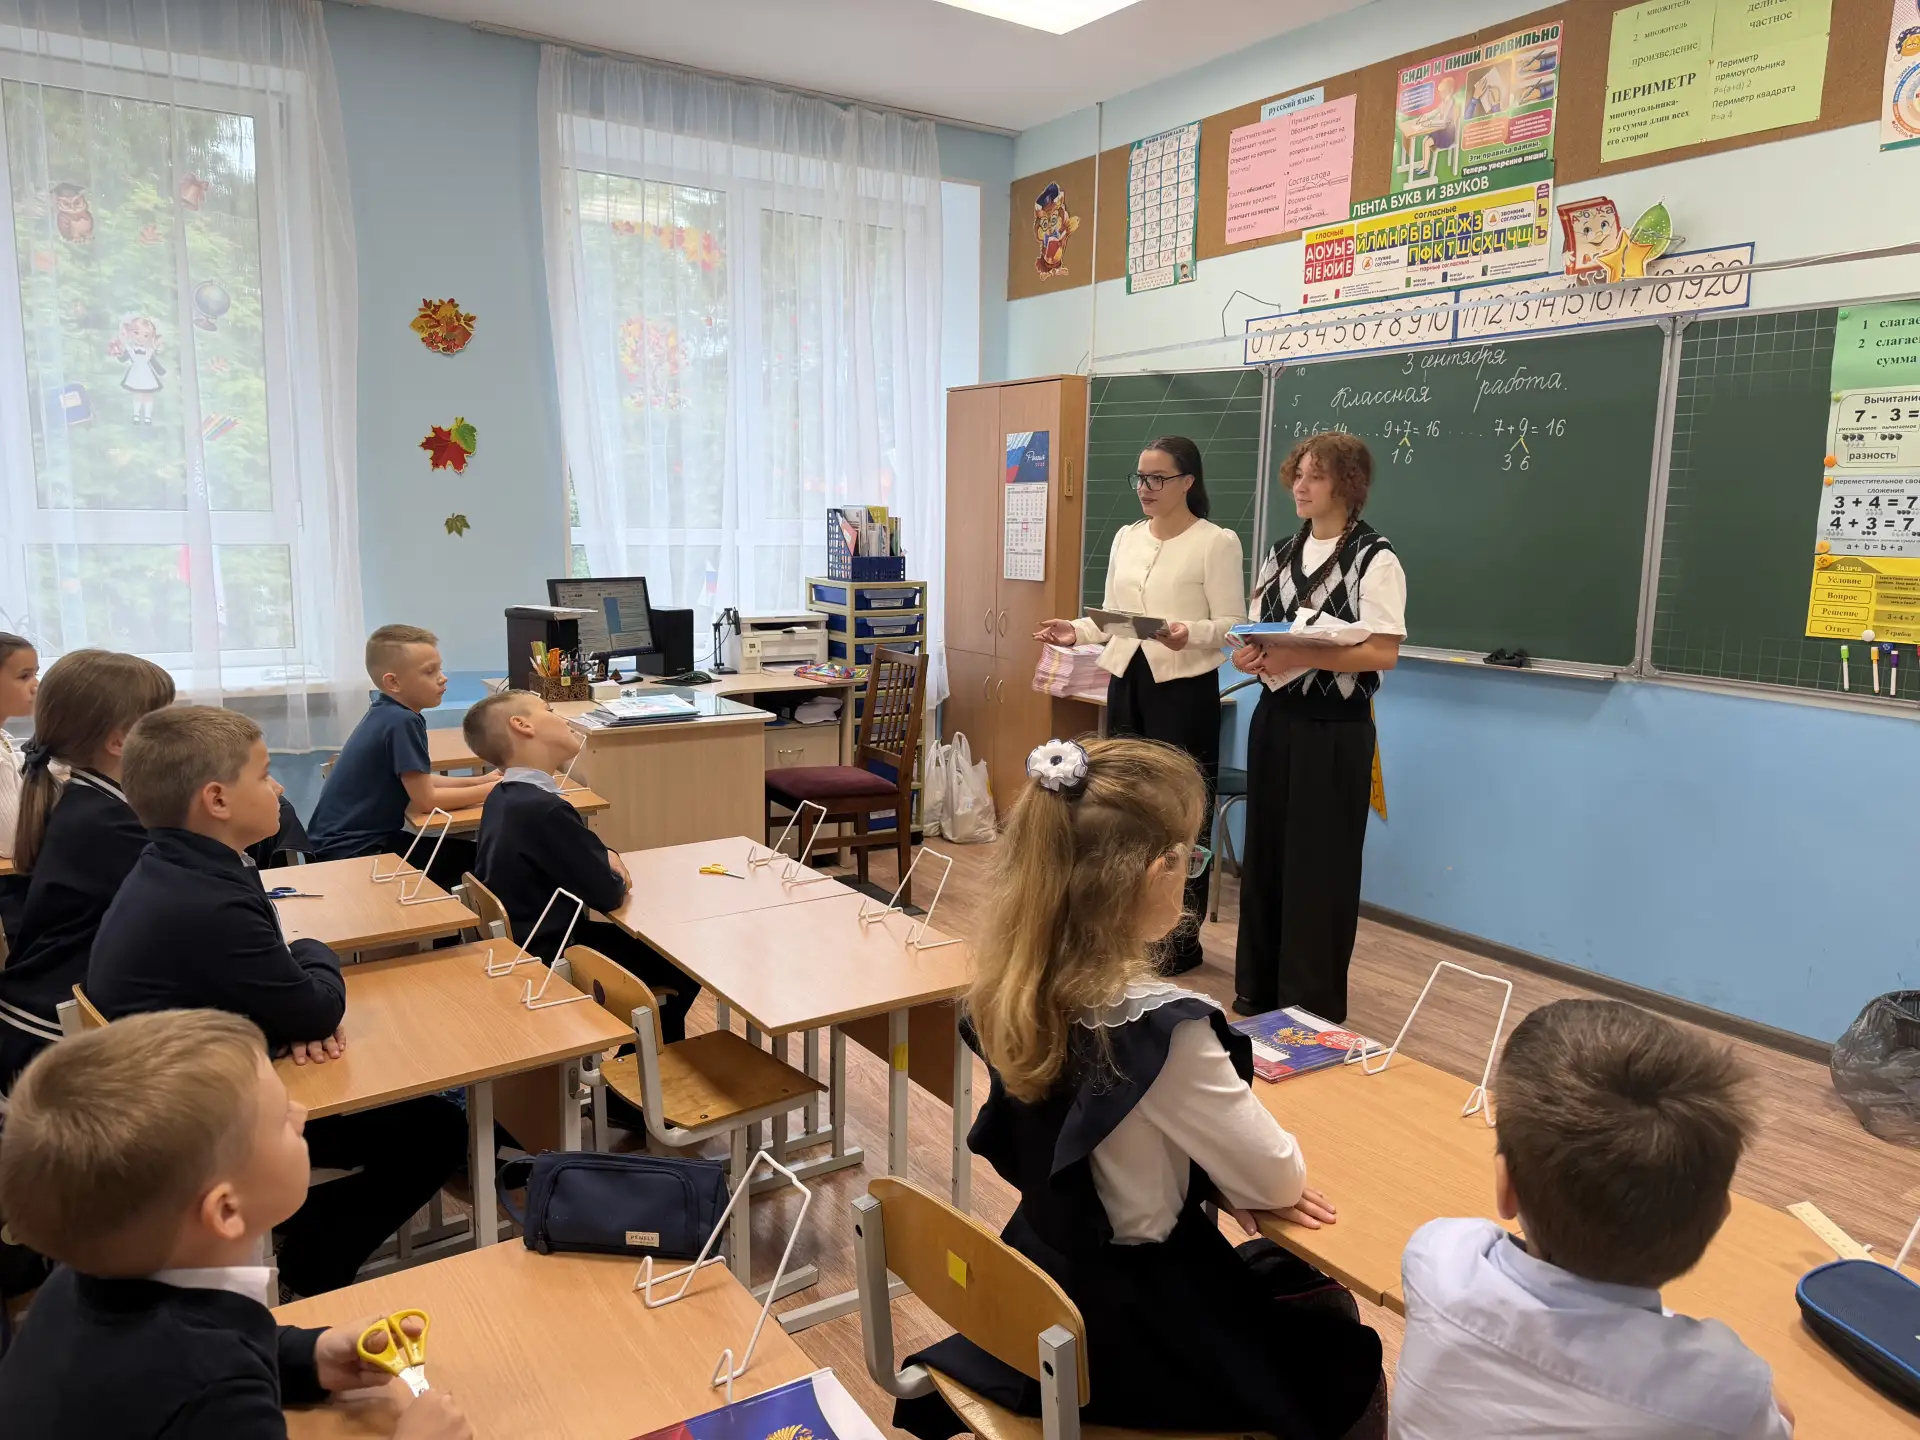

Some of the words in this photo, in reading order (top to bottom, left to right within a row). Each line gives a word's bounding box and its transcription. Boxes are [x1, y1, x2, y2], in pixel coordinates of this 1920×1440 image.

[1636, 11, 1640, 20] 1
[1647, 0, 1691, 16] множитель
[1749, 10, 1793, 28] частное
[1633, 33, 1638, 42] 2
[1644, 22, 1688, 39] множитель
[1401, 64, 1432, 84] СИДИ
[1433, 62, 1442, 75] И
[1445, 50, 1482, 71] ПИШИ
[1484, 25, 1560, 60] ПРАВИЛЬНО
[1632, 42, 1698, 67] произведение
[1717, 53, 1759, 69] Периметр
[1715, 59, 1786, 82] прямоугольника
[1611, 72, 1697, 104] ПЕРИМЕТР
[1712, 93, 1755, 108] Периметр
[1756, 84, 1796, 99] квадрата
[1268, 99, 1296, 117] русский
[1297, 94, 1315, 107] язык
[1608, 126, 1621, 134] это
[1622, 121, 1648, 132] сумма
[1649, 115, 1670, 126] длин
[1672, 110, 1690, 119] всех
[1606, 138, 1620, 146] его
[1621, 132, 1649, 143] сторон
[1463, 164, 1488, 176] Теперь
[1488, 157, 1523, 172] уверенно
[1523, 149, 1547, 163] пиши!
[1468, 152, 1481, 163] Эти
[1482, 147, 1512, 160] правила
[1288, 174, 1310, 187] Состав
[1311, 170, 1331, 181] слова
[1352, 199, 1388, 218] ЛЕНТА
[1390, 190, 1422, 209] БУКВ
[1426, 187, 1436, 200] И
[1439, 176, 1489, 199] ЗВУКОВ
[1414, 205, 1457, 220] согласные
[1500, 207, 1525, 217] звонкие
[1500, 212, 1531, 223] согласные
[1571, 204, 1613, 224] Азбука
[1315, 228, 1344, 240] гласные
[1374, 259, 1400, 268] согласные
[1441, 259, 1470, 269] согласные
[1863, 320, 1868, 330] 1
[1858, 338, 1865, 349] 2
[1402, 352, 1414, 375] 3
[1420, 344, 1508, 381] сентября
[1877, 355, 1917, 368] сумма
[1295, 367, 1306, 377] 10
[1292, 394, 1302, 407] 5
[1330, 386, 1433, 409] Классная
[1854, 410, 1866, 423] 7
[1889, 408, 1901, 422] 3
[1501, 454, 1512, 471] 3
[1520, 456, 1531, 471] 6
[1849, 452, 1896, 462] разность
[1835, 478, 1904, 487] переместительное
[1834, 496, 1845, 509] 3
[1868, 496, 1881, 509] 4
[1906, 496, 1918, 509] 7
[1829, 516, 1842, 529] 4
[1866, 517, 1877, 530] 3
[1903, 518, 1914, 531] 7
[1836, 564, 1862, 572] Задача
[1827, 576, 1862, 585] Условие
[1827, 592, 1858, 601] Вопрос
[1822, 608, 1859, 618] Решение
[1825, 624, 1850, 633] Ответ
